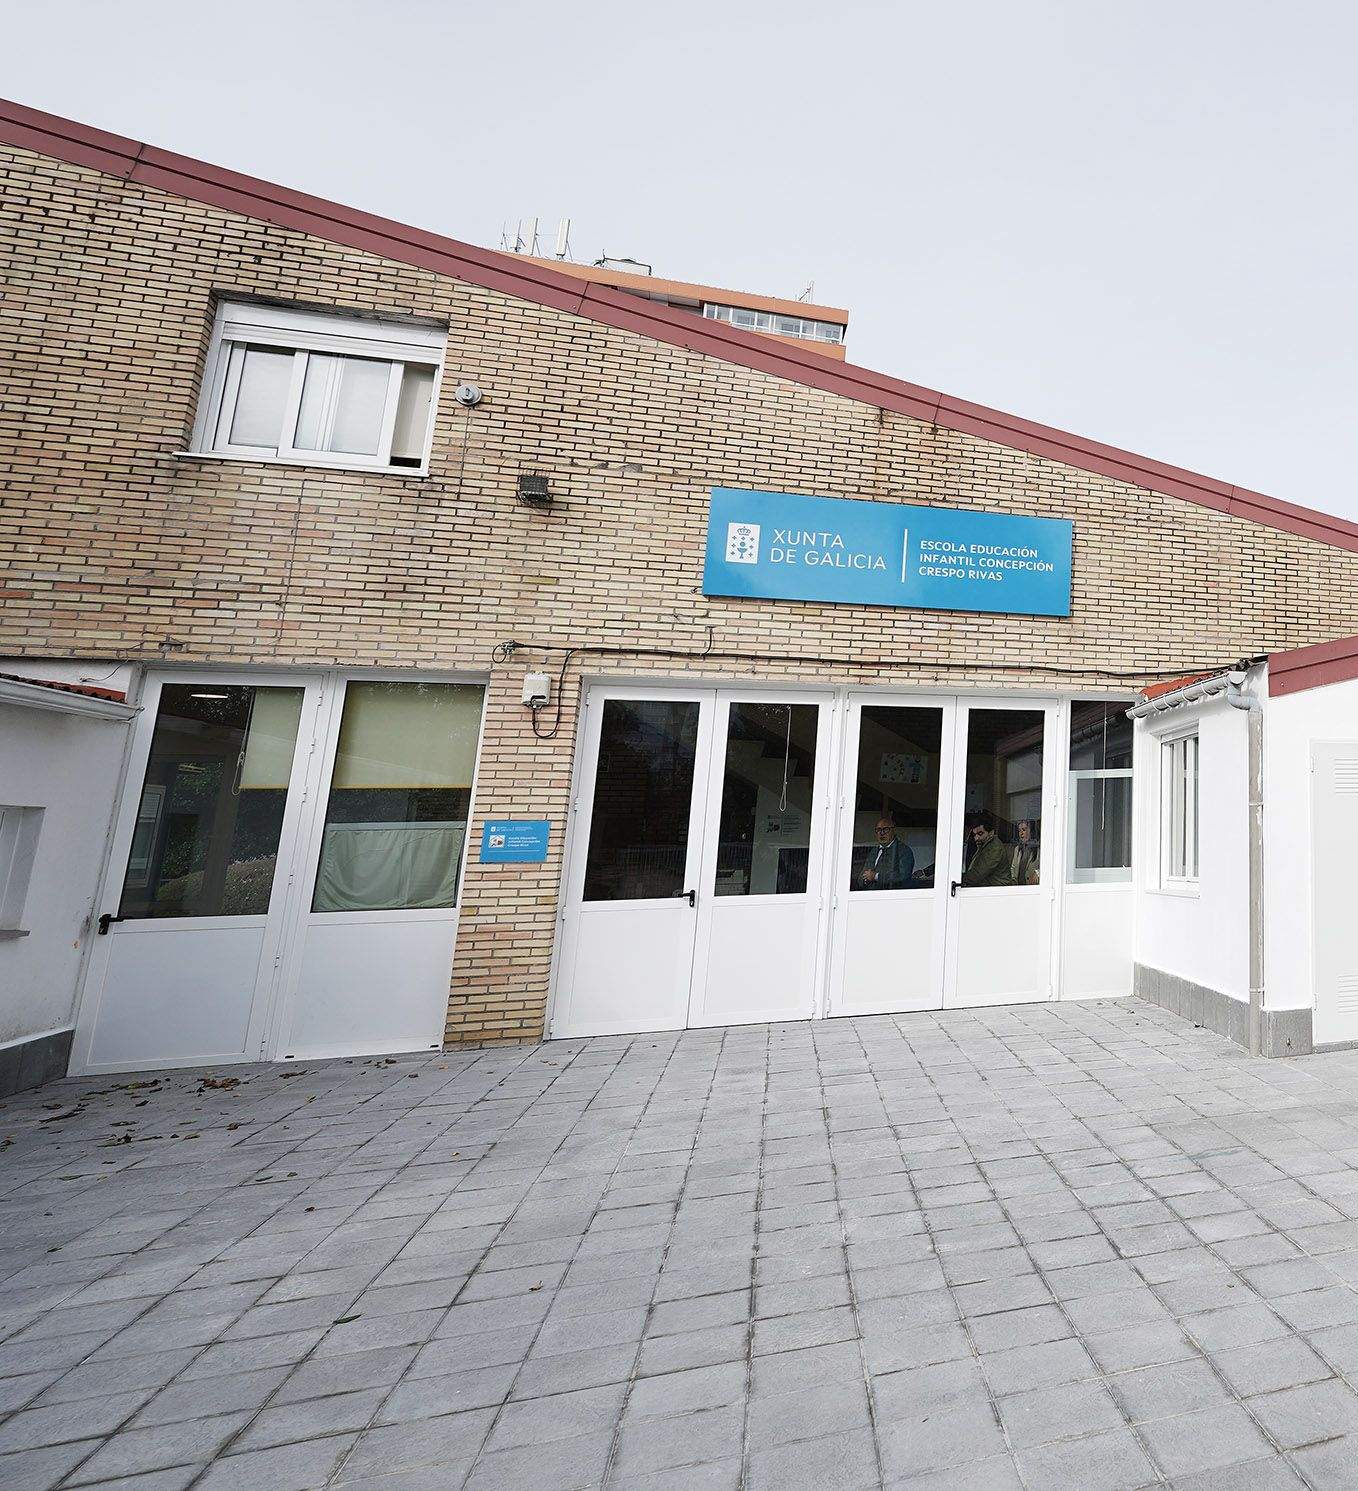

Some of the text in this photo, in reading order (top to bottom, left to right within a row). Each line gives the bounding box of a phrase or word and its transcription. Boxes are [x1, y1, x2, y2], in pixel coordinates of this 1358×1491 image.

[773, 529, 844, 549] XUNTA
[920, 540, 1038, 558] ESCOLA EDUCACIÓN
[770, 548, 887, 570] DE GALICIA
[920, 553, 1054, 572] INFANTIL CONCEPCIÓN
[919, 566, 1003, 581] CRESPO RIVAS
